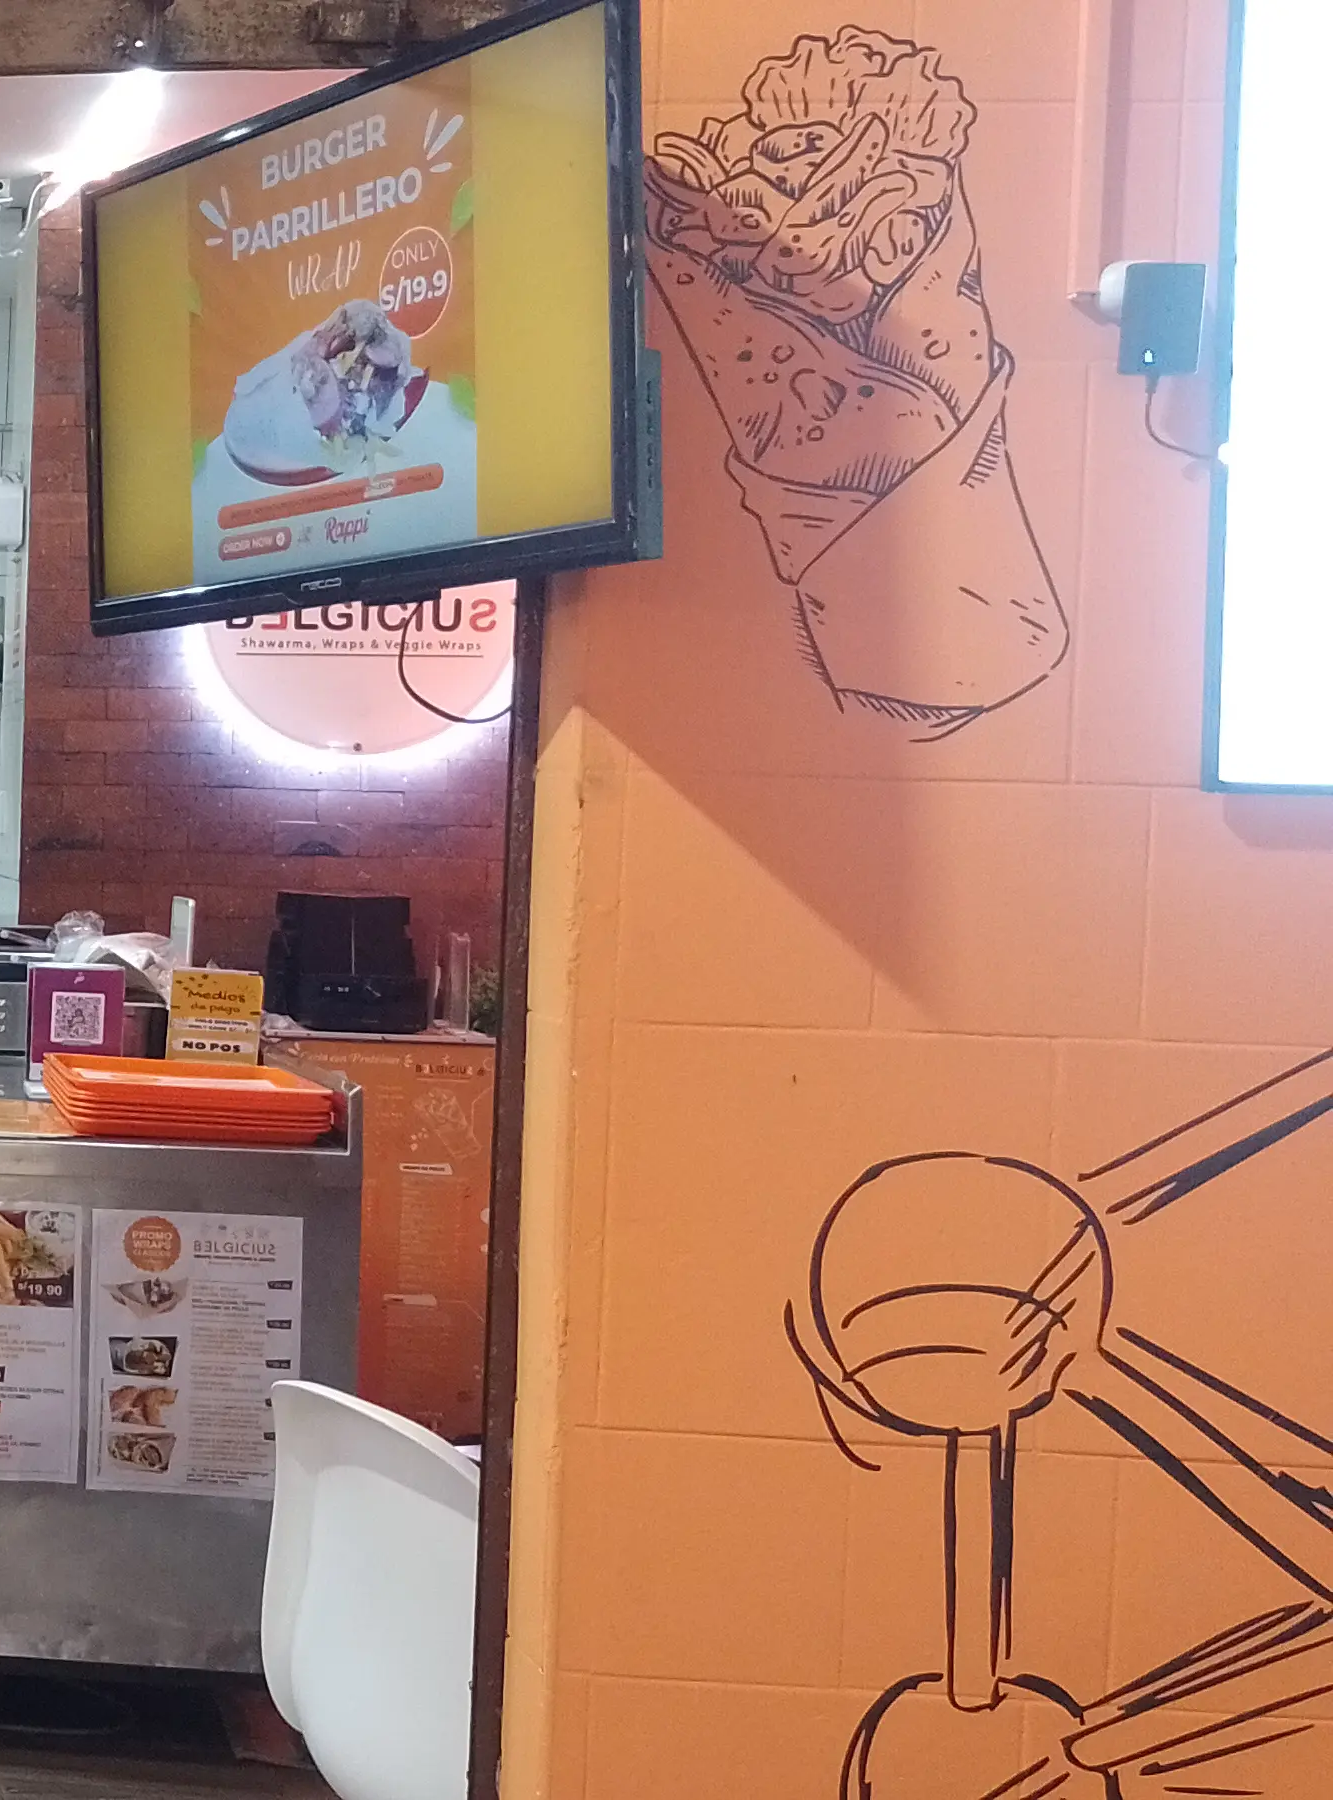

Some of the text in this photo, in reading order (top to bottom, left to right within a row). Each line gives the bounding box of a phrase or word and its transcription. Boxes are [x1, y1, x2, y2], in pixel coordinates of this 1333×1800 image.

[261, 114, 386, 190] BURGER
[232, 167, 422, 261] PARRILLERO
[391, 238, 439, 269] ONLY
[288, 239, 361, 300] WRAP
[381, 270, 447, 312] S/19.9
[325, 509, 371, 544] Rappi
[241, 638, 316, 650] Shawarma,
[322, 638, 364, 651] Wraps
[371, 639, 379, 649] &
[439, 639, 481, 651] Wraps
[188, 990, 246, 1004] Medios
[209, 1005, 241, 1016] pago
[182, 1041, 241, 1053] NO POS
[132, 1231, 173, 1240] PROMO
[133, 1240, 172, 1250] WRAPS
